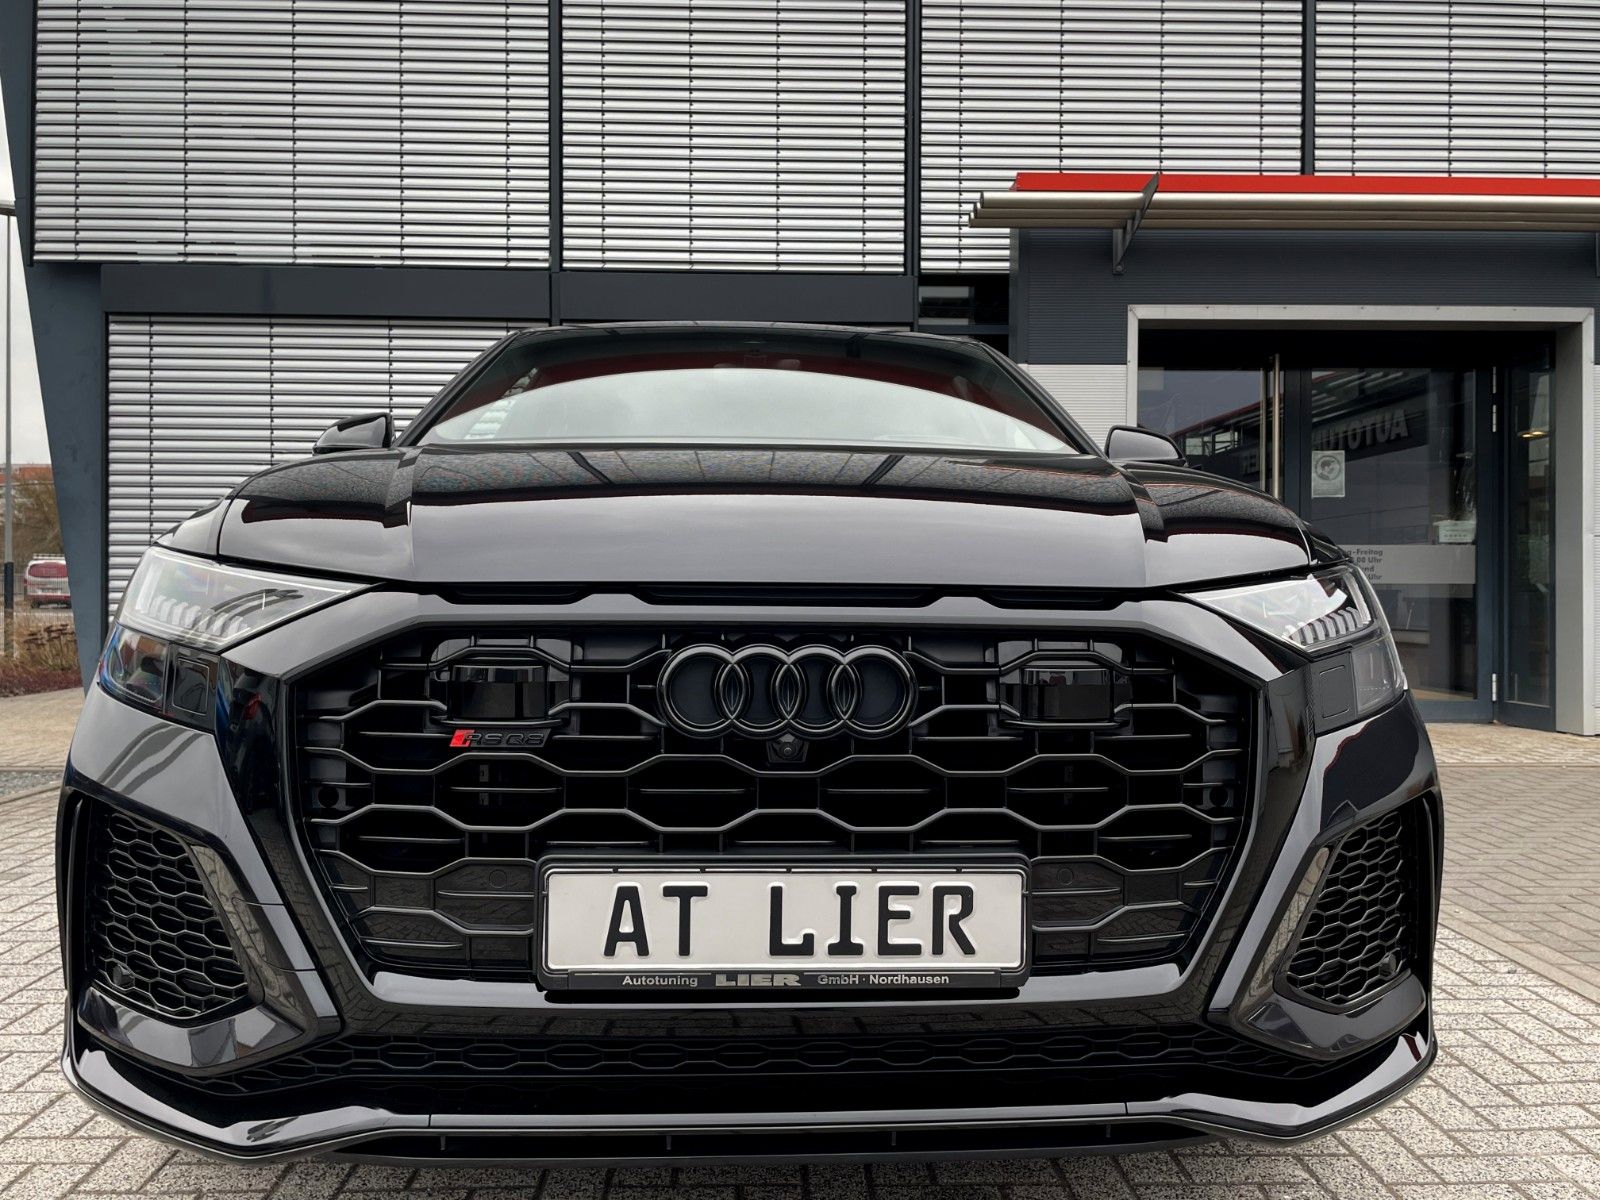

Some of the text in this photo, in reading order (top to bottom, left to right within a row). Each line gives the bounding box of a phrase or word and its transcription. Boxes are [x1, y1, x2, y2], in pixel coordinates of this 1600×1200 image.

[604, 885, 975, 956] AT LIER
[622, 974, 950, 987] Autotuning LIER GmbH Nordhausen
